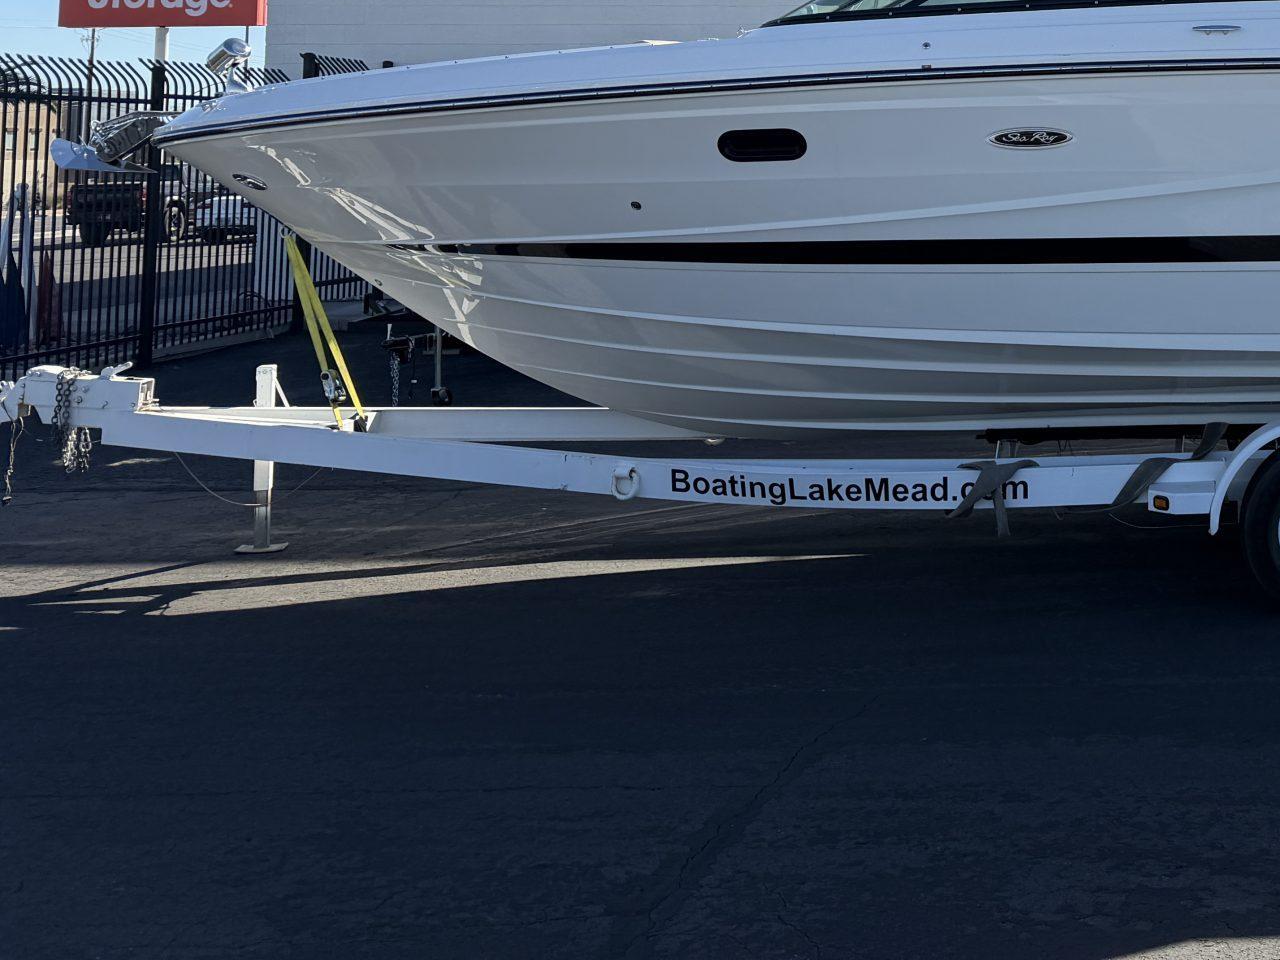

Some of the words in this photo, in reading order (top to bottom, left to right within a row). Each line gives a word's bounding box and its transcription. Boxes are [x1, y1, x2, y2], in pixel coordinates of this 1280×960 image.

[1002, 132, 1029, 142] Sea
[1030, 131, 1059, 144] Ray
[670, 468, 1029, 505] BoatingLakeMead.cm
